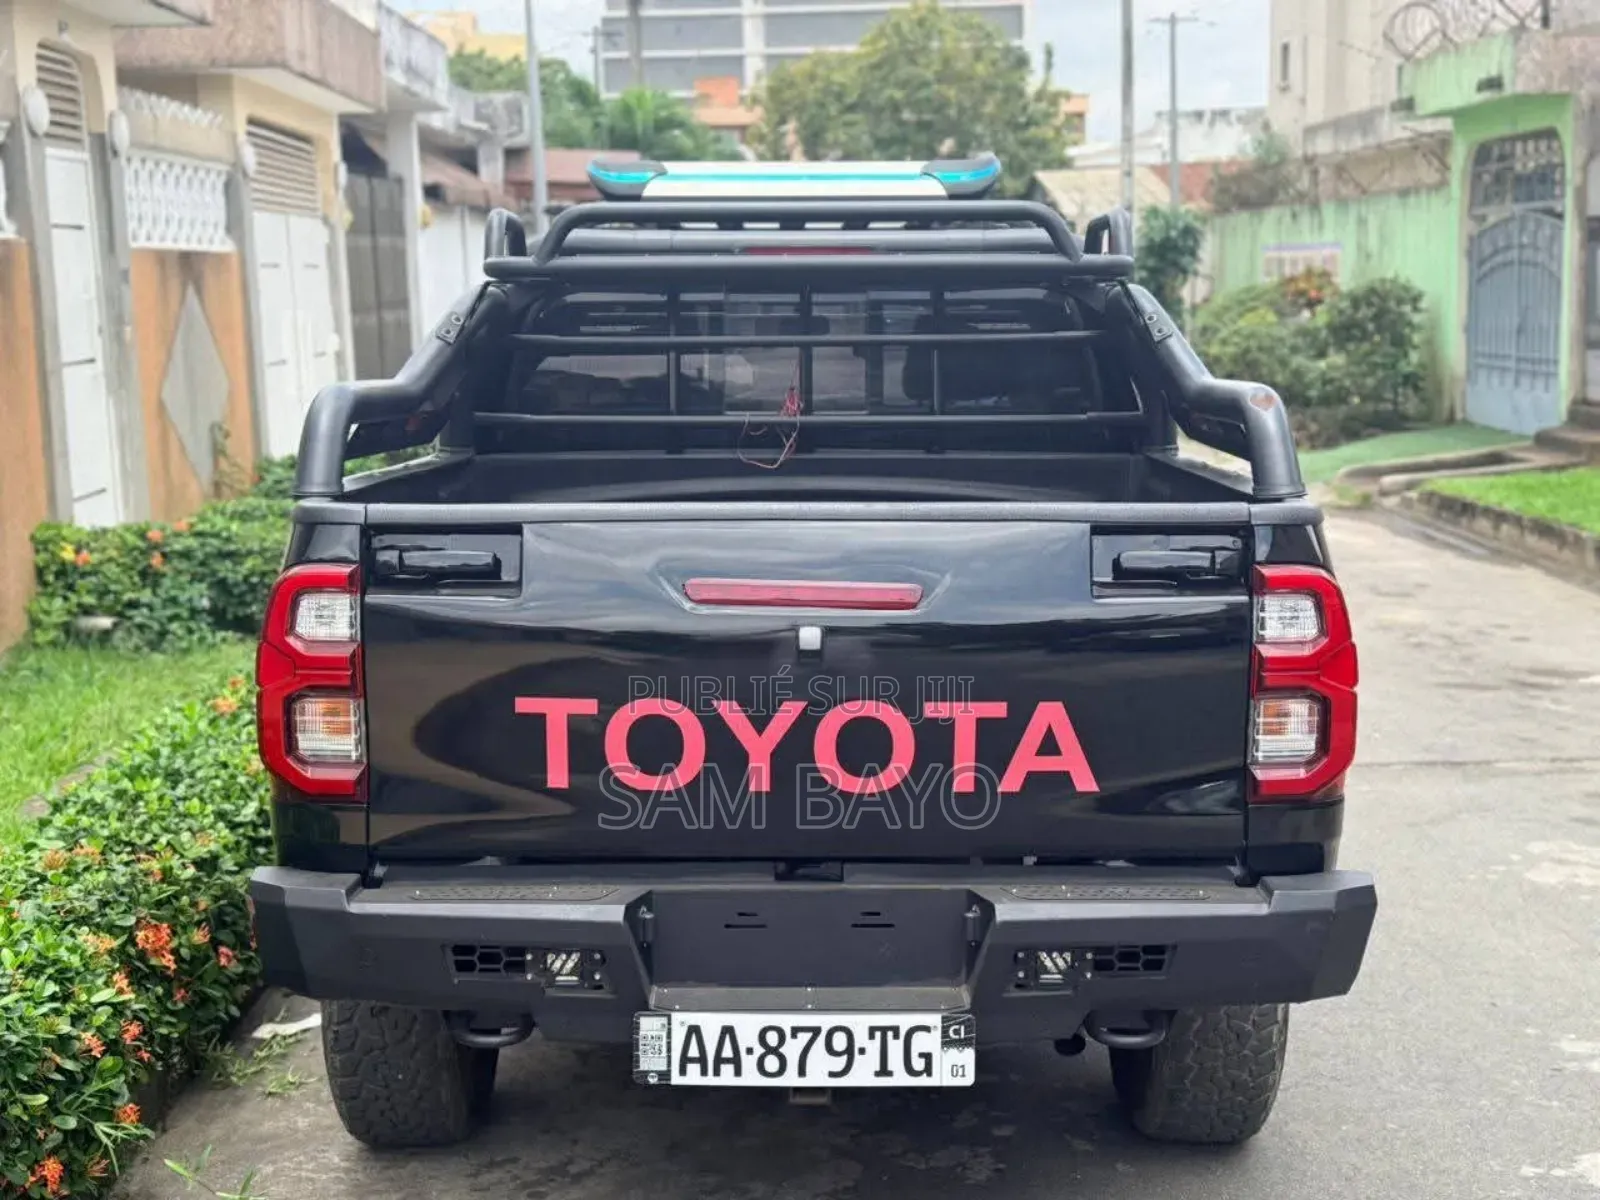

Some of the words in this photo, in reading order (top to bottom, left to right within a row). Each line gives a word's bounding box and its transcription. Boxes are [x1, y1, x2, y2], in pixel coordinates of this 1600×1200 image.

[514, 696, 1101, 794] TOYOTA
[949, 1024, 966, 1039] CI
[950, 1064, 967, 1078] 01
